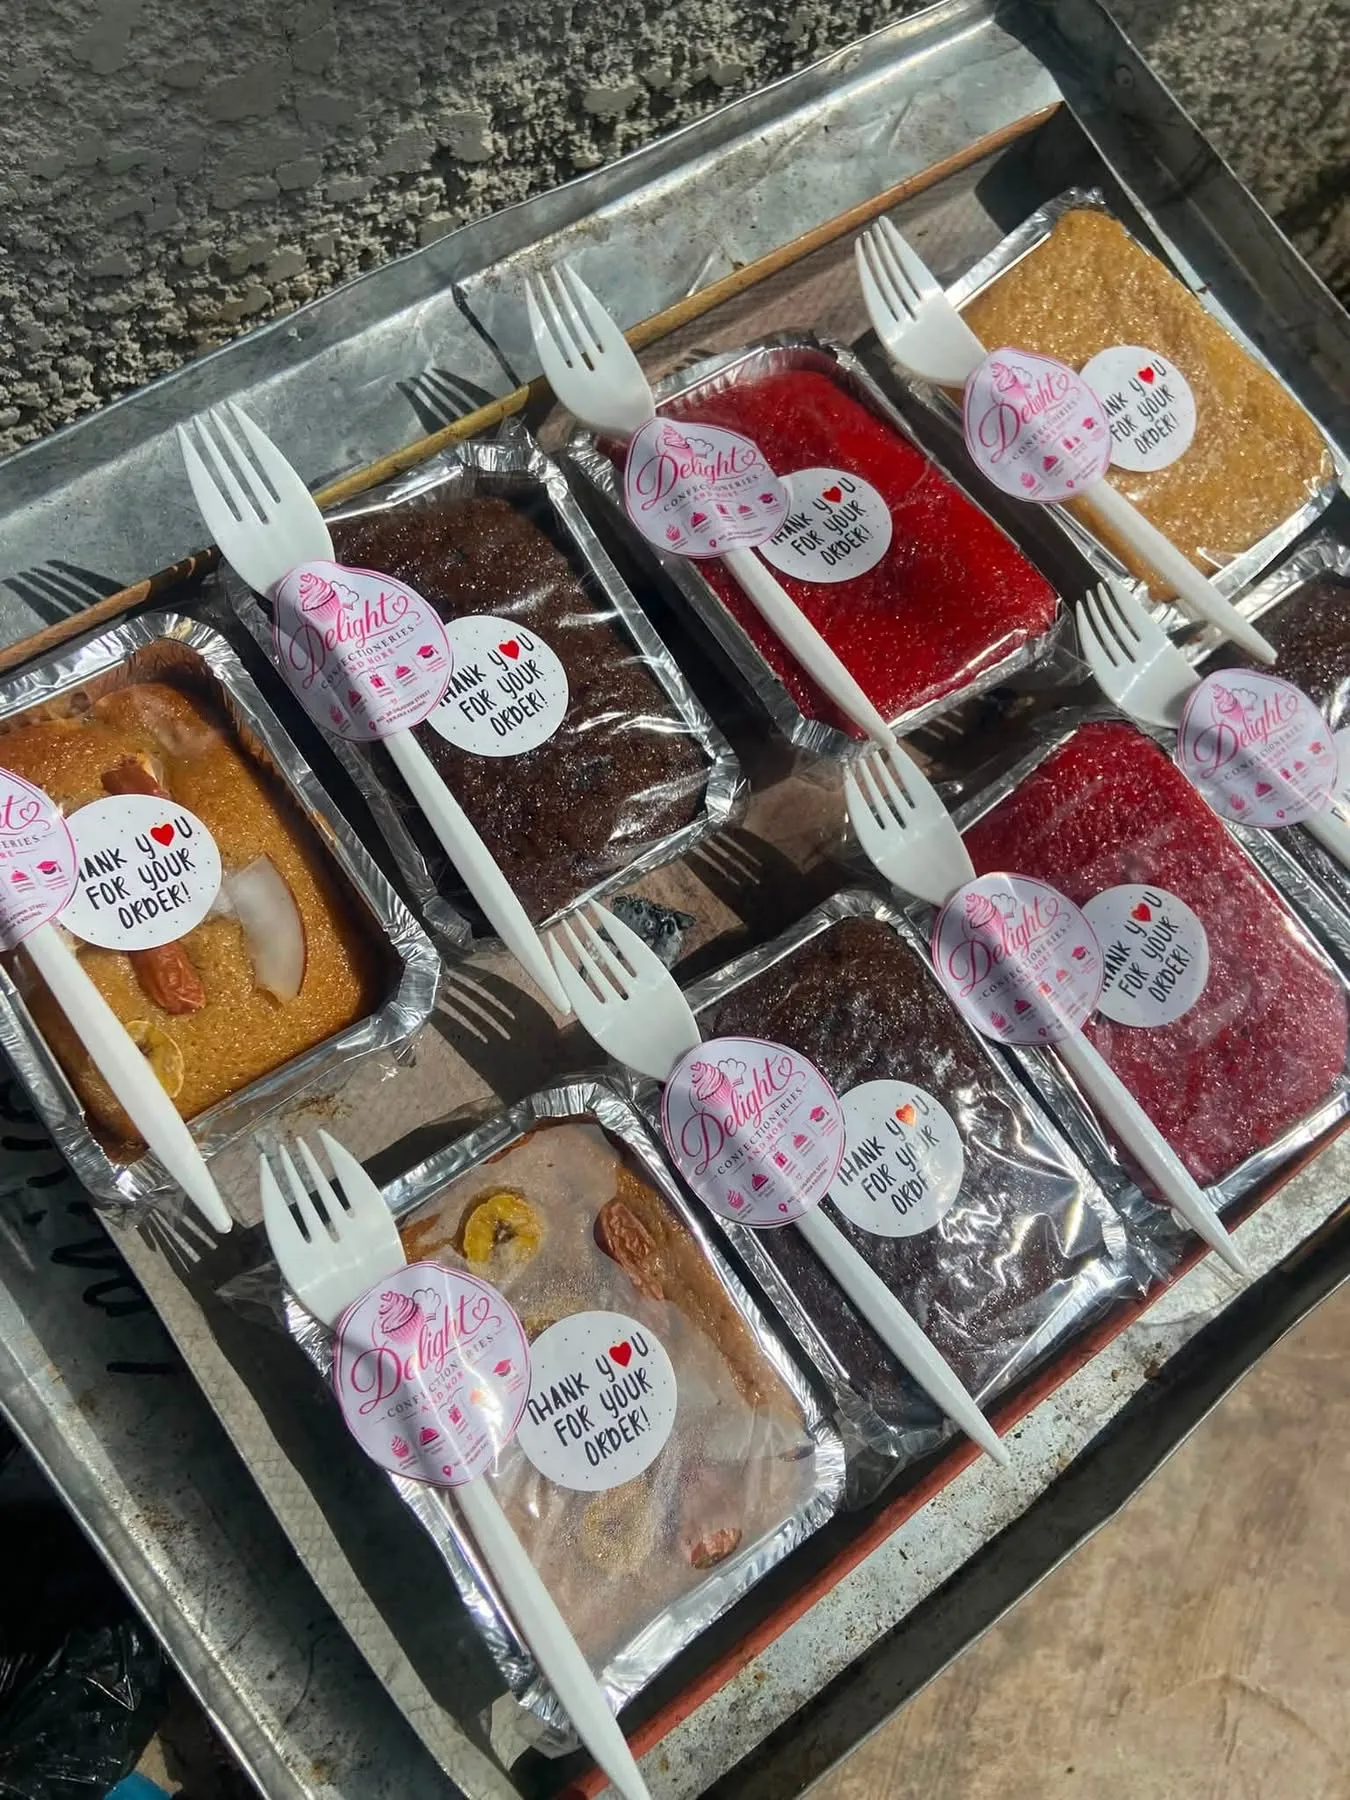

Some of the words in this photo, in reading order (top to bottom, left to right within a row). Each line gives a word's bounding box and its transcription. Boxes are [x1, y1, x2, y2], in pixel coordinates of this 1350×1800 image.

[1101, 392, 1128, 417] ANK
[1109, 414, 1138, 442] FOR
[1137, 384, 1175, 422] YOUR
[1134, 412, 1180, 454] ORDER!
[636, 446, 765, 511] Delight
[791, 530, 824, 556] FOR
[822, 500, 866, 535] YOUR
[820, 524, 873, 566] ORDER!
[288, 592, 421, 690] Delight
[321, 625, 415, 689] CONFECTIONERIES
[459, 688, 497, 722] FOR
[497, 659, 544, 699] YOUR
[490, 688, 549, 736] ORDER!
[1193, 692, 1300, 779] Delight
[78, 847, 128, 883] ANK
[86, 876, 131, 910] FOR
[138, 847, 196, 891] YOUR
[118, 881, 192, 929] ORDER!
[949, 896, 1070, 997] Delight
[1102, 941, 1131, 992] HANK
[1118, 962, 1149, 998] FOR
[1141, 915, 1179, 962] YOUR
[1148, 944, 1194, 1003] ORDER!
[681, 1057, 806, 1176] Delight
[718, 1088, 803, 1175] CONFECTIONERIES
[861, 1163, 896, 1201] FOR
[351, 1294, 502, 1415] Delight
[527, 1372, 590, 1425] THANK
[554, 1404, 595, 1446] FOR
[600, 1367, 653, 1419] YOUR
[584, 1405, 651, 1467] ORDER!
